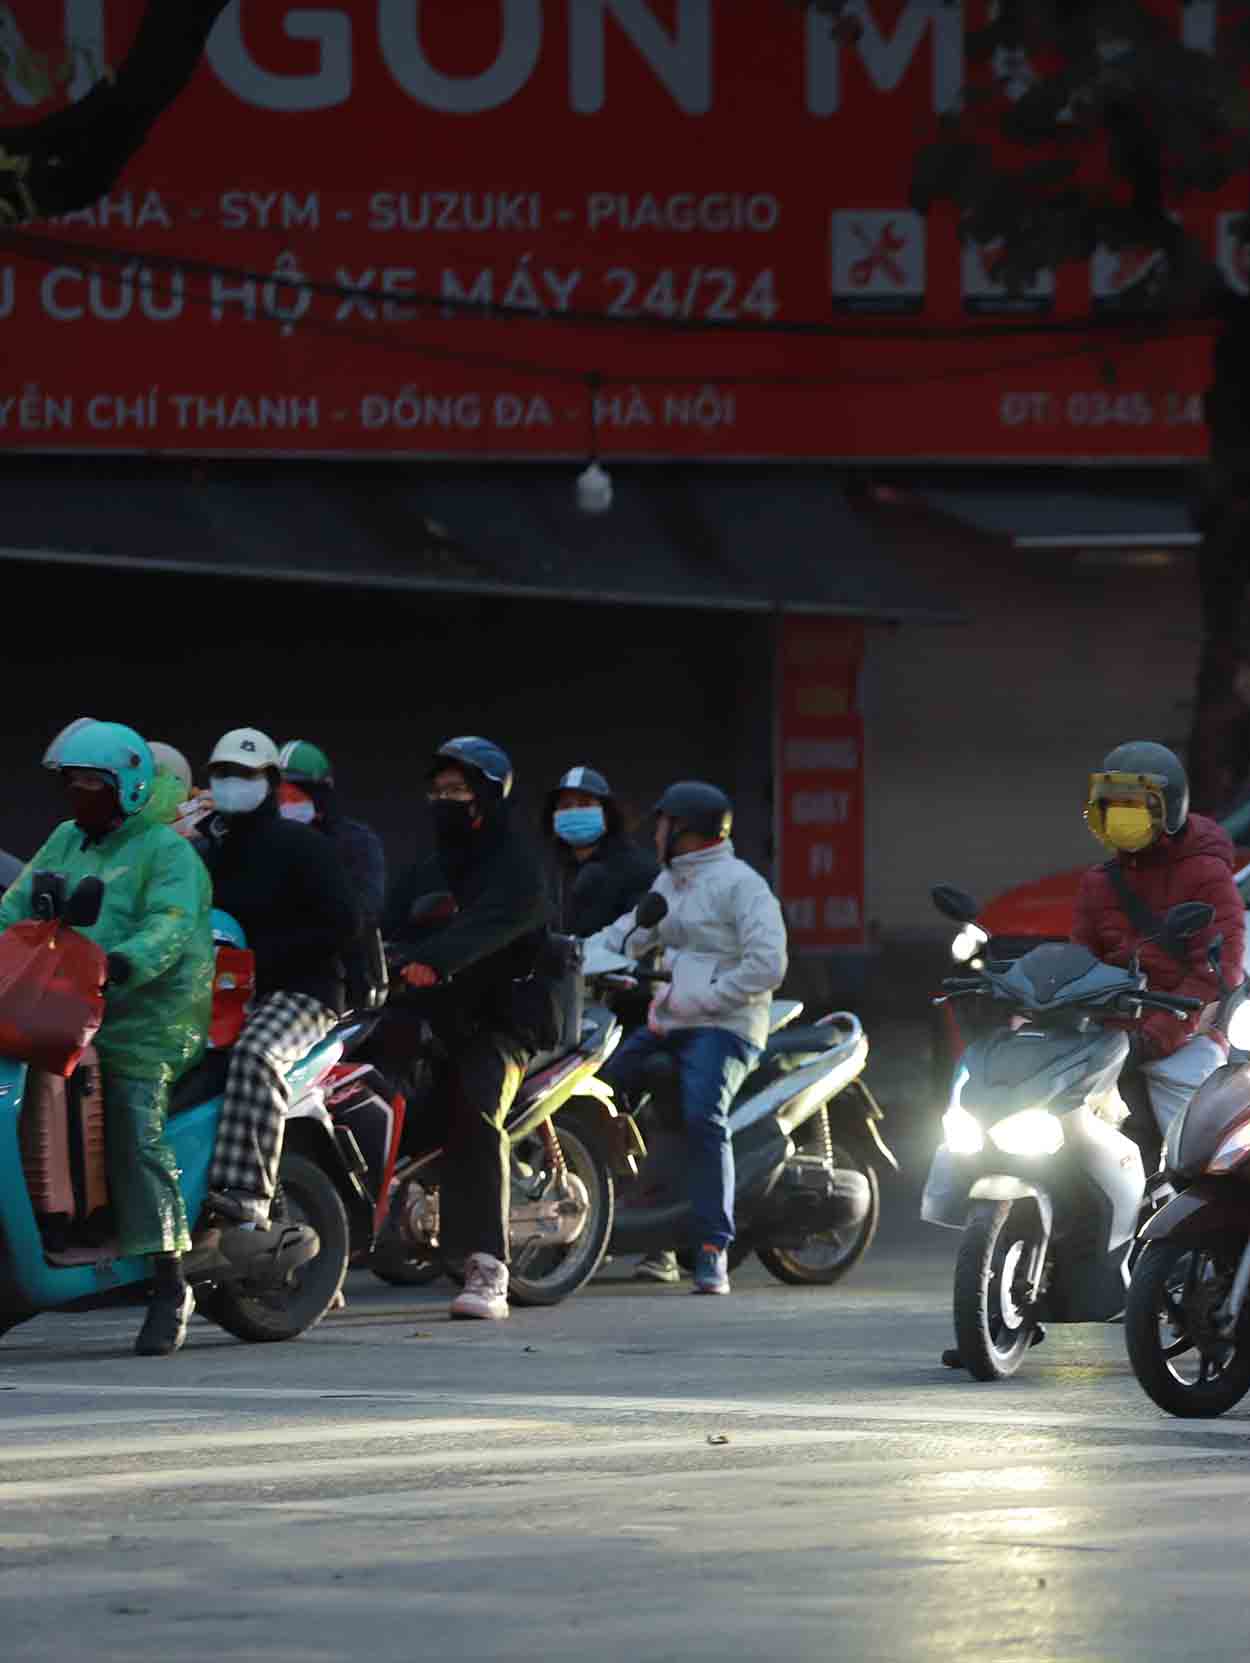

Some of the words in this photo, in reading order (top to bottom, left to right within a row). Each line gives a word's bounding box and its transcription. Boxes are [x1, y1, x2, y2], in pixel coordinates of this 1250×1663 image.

[219, 190, 321, 231] SYM
[367, 190, 544, 232] SUZUKI
[586, 190, 782, 232] PIAGGIO
[335, 265, 418, 321] XE
[604, 264, 782, 321] 24/24
[87, 383, 161, 432] CHÍ
[167, 393, 321, 432] THANH
